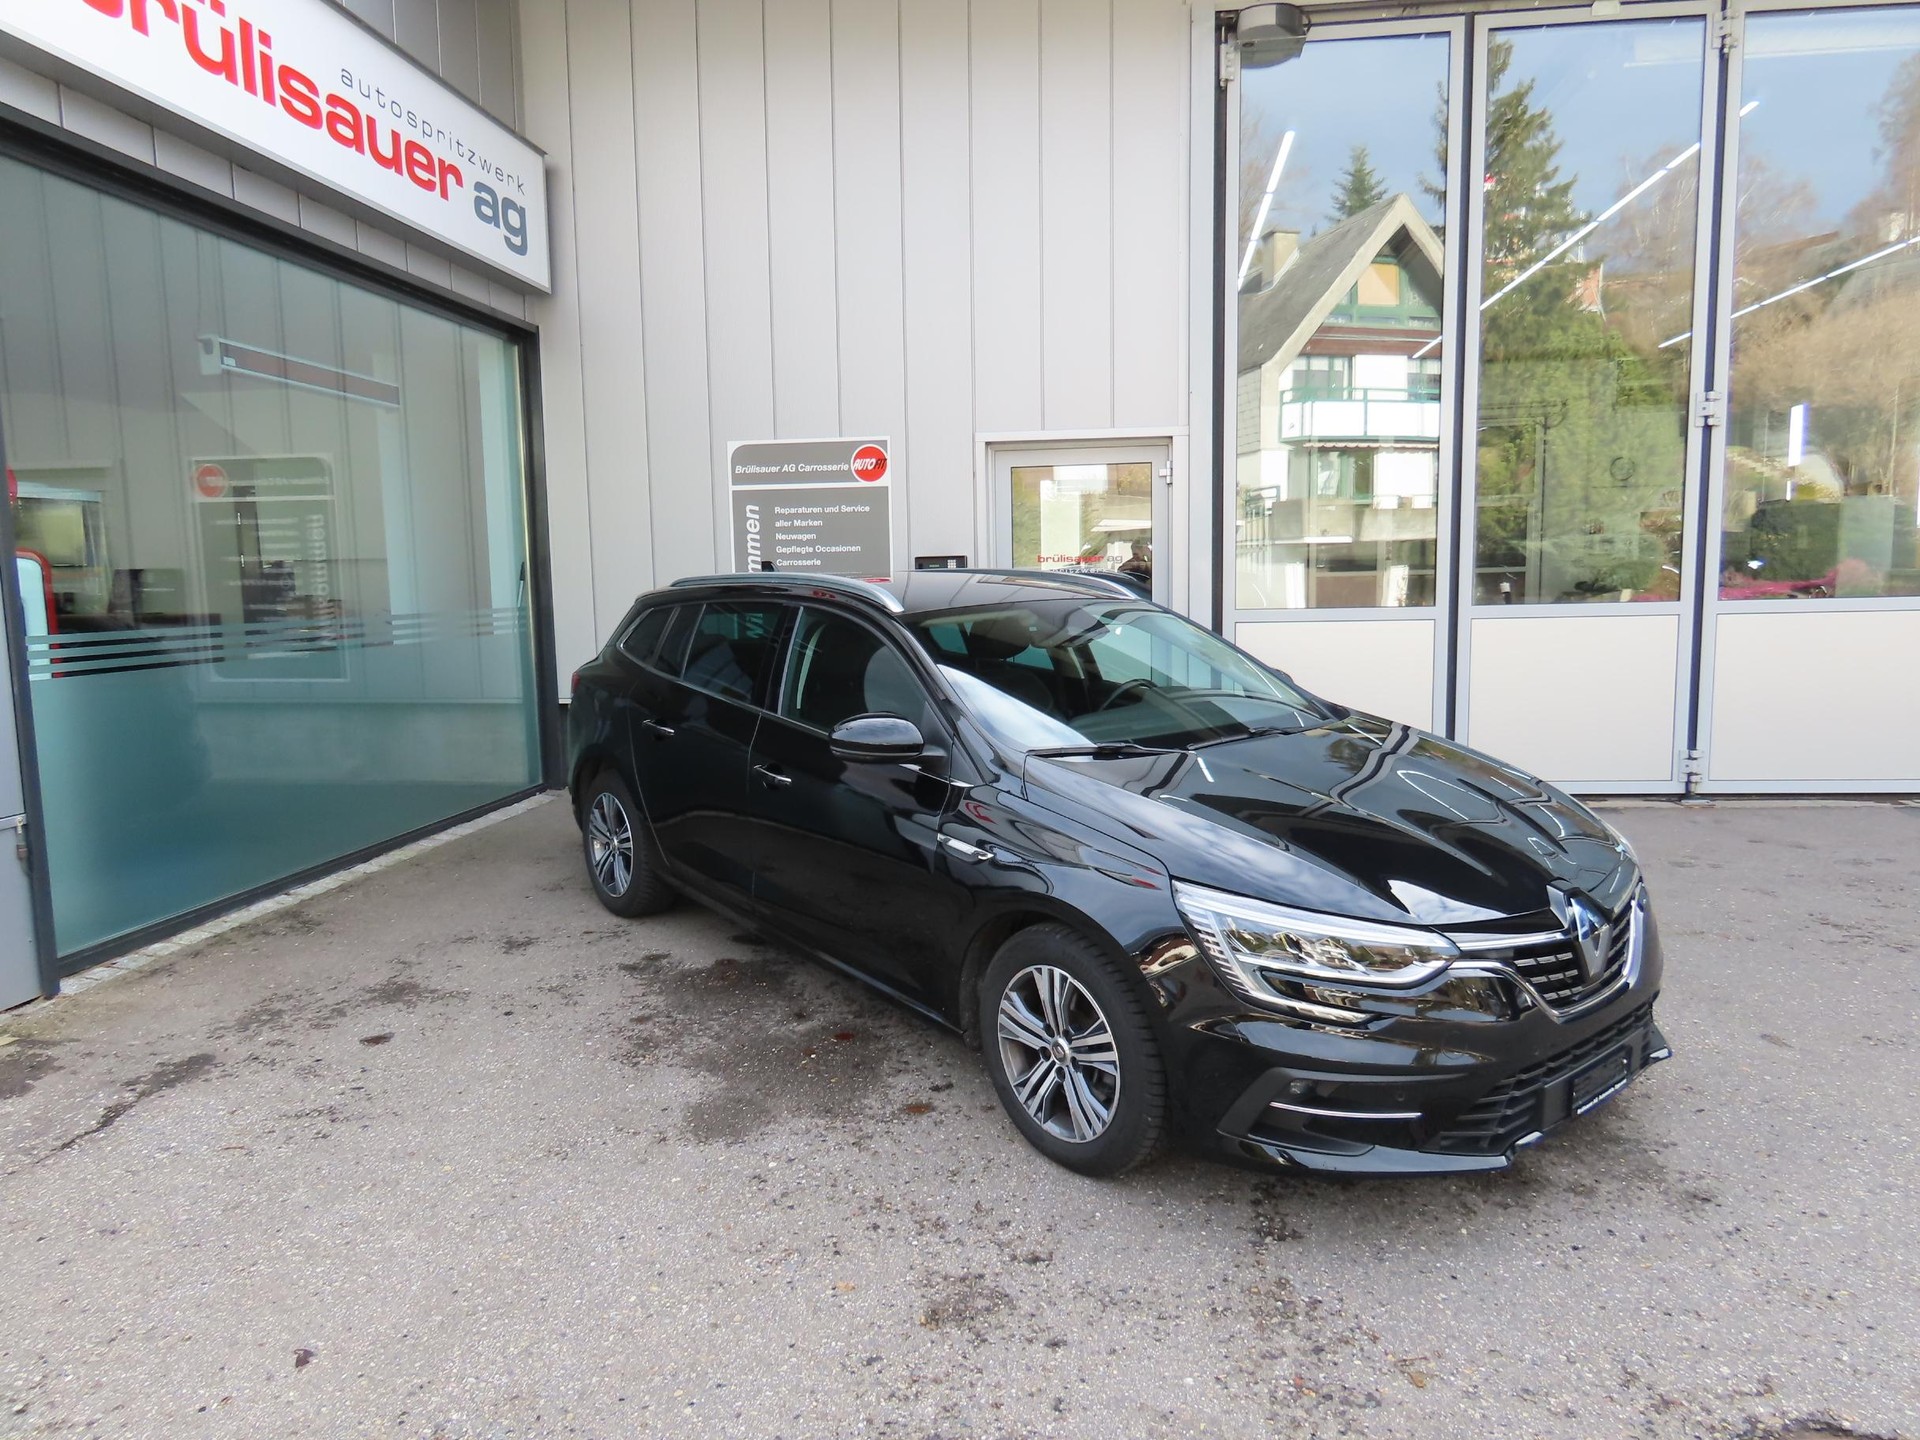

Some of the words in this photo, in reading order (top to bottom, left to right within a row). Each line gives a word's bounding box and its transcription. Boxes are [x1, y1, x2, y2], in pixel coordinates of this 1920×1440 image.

[83, 0, 464, 201] rülisauer
[474, 181, 528, 256] ag
[341, 68, 526, 196] autospritzwerk
[735, 464, 780, 474] Brülisauer
[782, 463, 796, 473] AG
[798, 462, 849, 472] Carrosserie
[775, 505, 823, 515] Reparaturen
[824, 505, 839, 513] und
[840, 504, 870, 513] Service
[775, 519, 791, 527] aller
[793, 519, 823, 527] Marken
[746, 504, 762, 573] mmen
[775, 532, 817, 541] Neuwagen
[776, 545, 814, 554] Gepflegte
[815, 544, 861, 553] Occasionen
[776, 558, 821, 566] Carrosserie
[1106, 555, 1123, 563] ag
